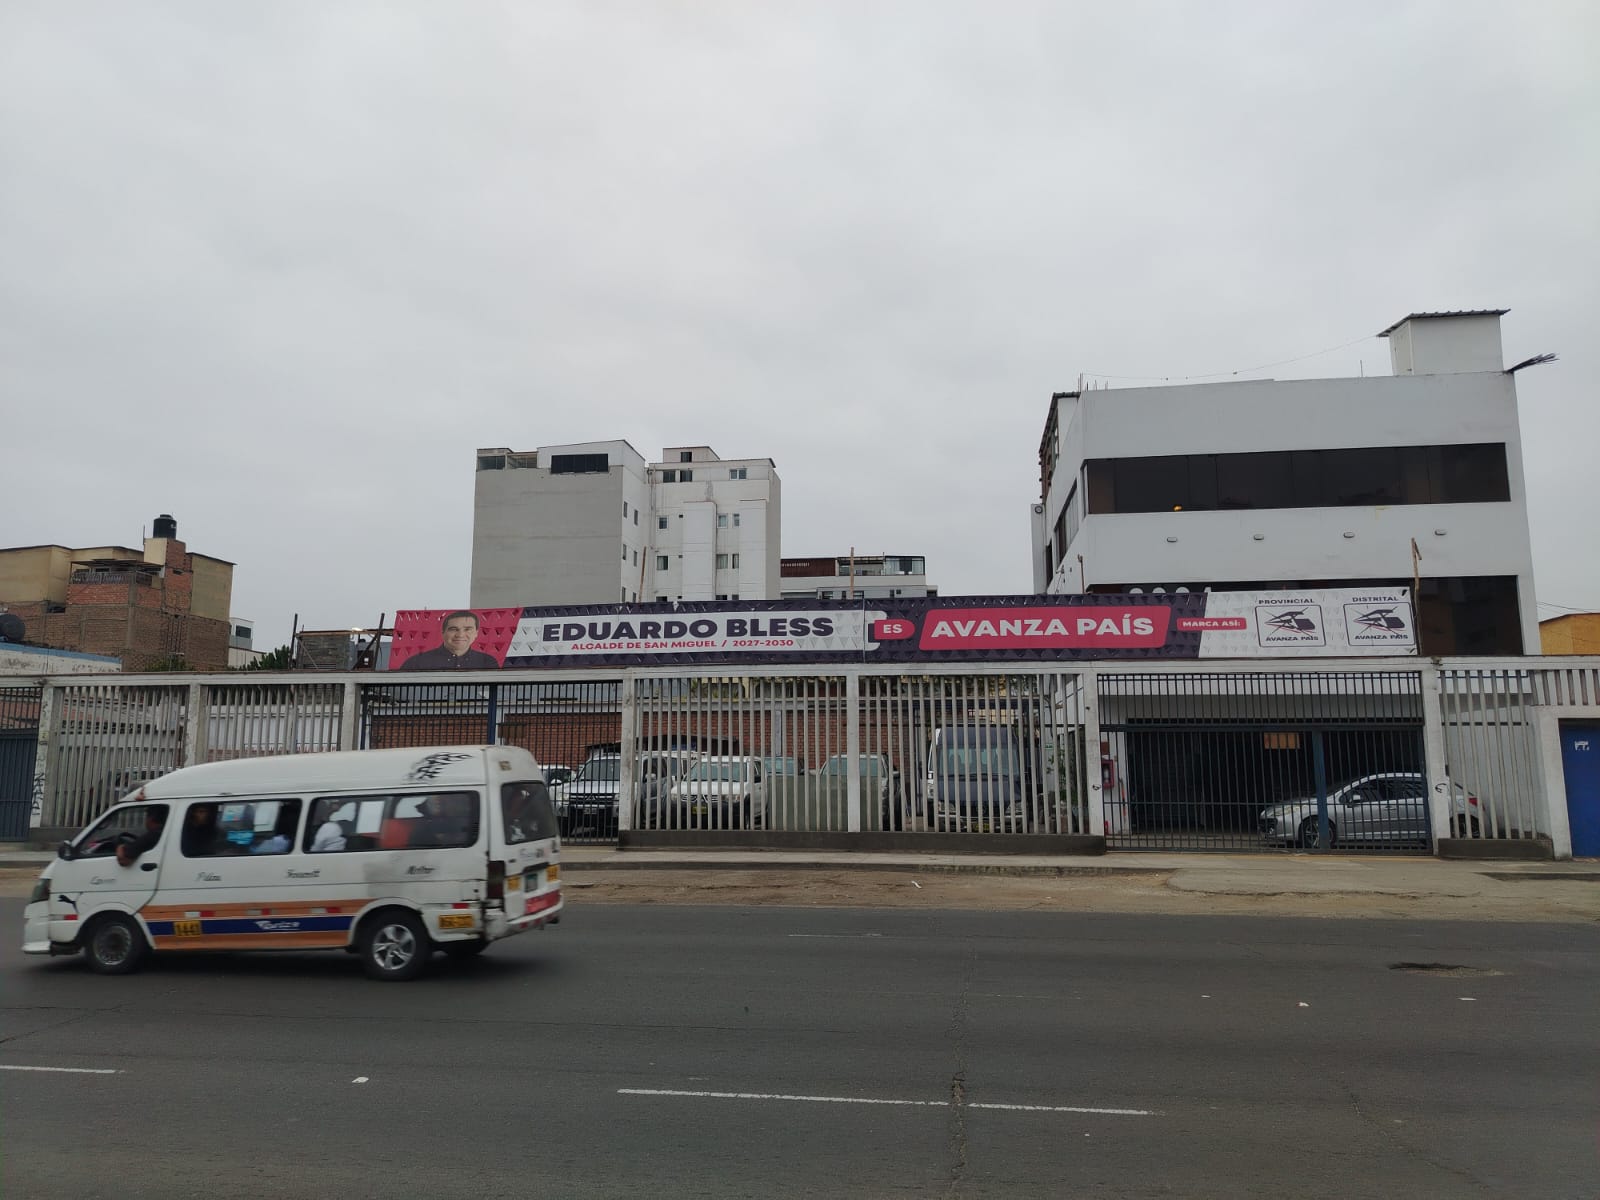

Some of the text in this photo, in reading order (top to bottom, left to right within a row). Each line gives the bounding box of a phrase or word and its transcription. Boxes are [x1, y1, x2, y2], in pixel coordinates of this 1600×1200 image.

[543, 617, 834, 642] EDUARDO BLESS
[883, 624, 903, 634] ES
[931, 613, 1154, 638] AVANZA PAÍS
[1182, 620, 1219, 628] MARCA
[571, 639, 794, 650] ALCALDE DE SAN MIGUEL / 2027-2030
